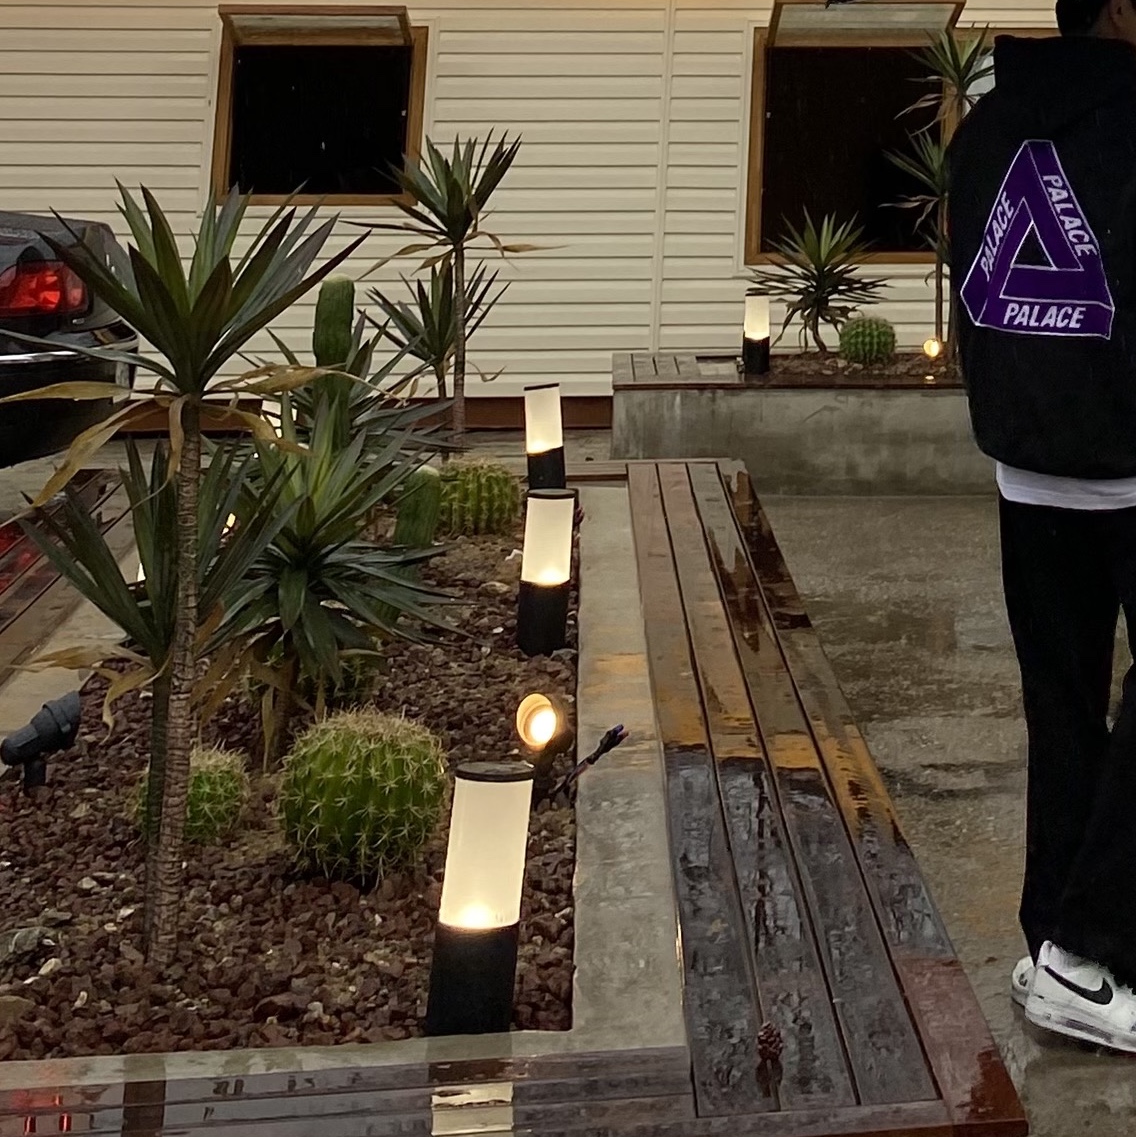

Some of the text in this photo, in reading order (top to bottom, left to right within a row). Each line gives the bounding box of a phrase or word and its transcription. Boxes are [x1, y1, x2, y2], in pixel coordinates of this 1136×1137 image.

[979, 191, 1015, 283] PALACE
[1042, 173, 1099, 258] PALACE
[1003, 302, 1087, 329] PALACE
